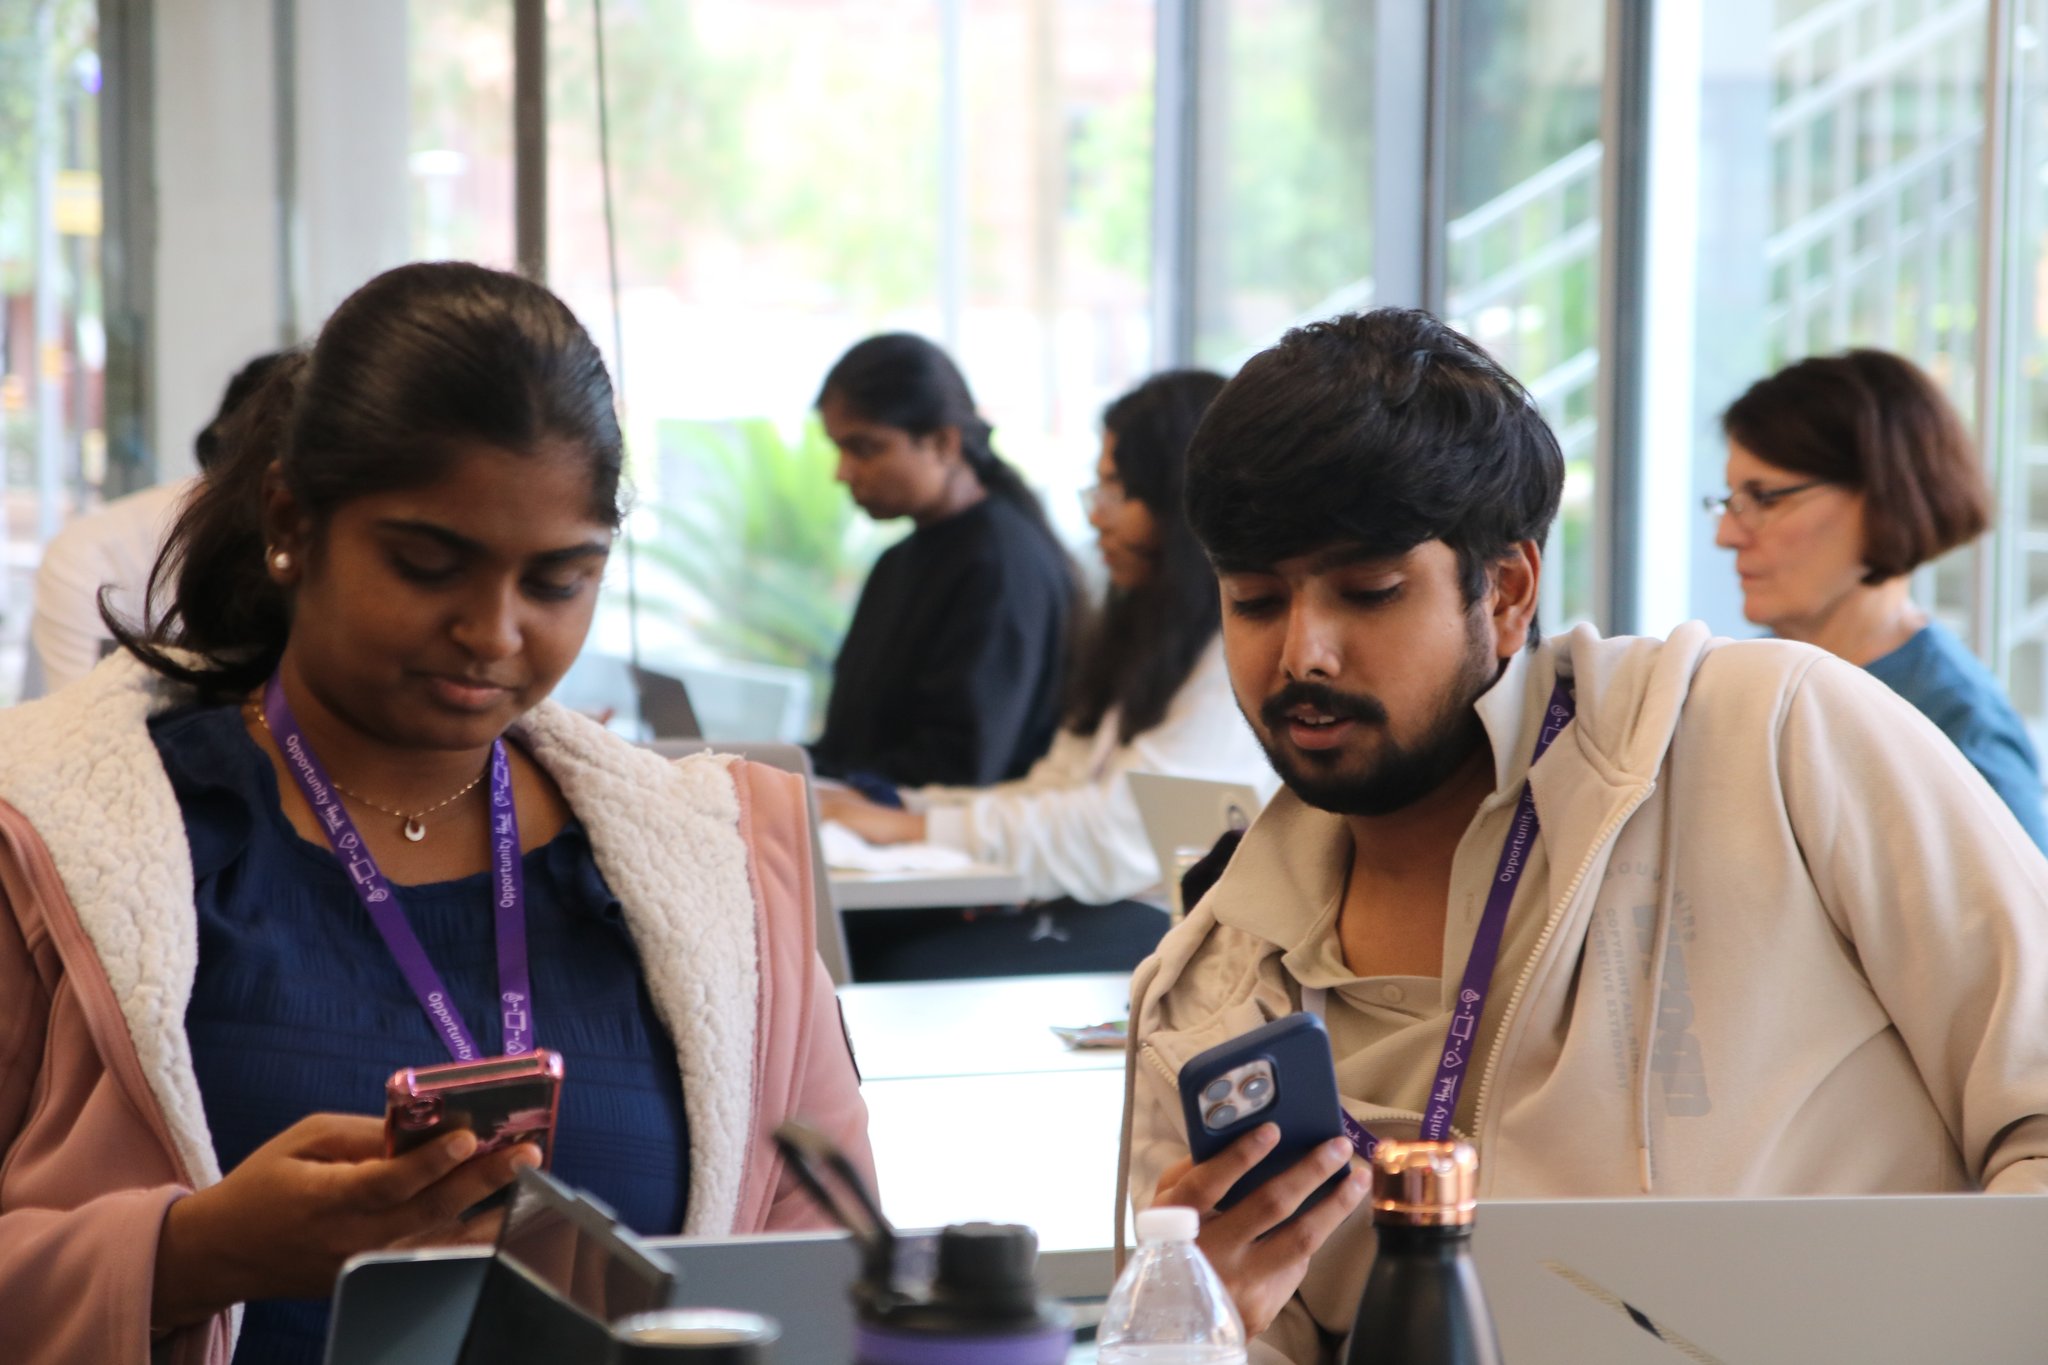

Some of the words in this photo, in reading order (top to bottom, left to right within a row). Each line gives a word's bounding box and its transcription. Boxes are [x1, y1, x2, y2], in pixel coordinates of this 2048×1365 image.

[286, 733, 331, 806] Opportunity
[319, 804, 344, 835] Hack
[496, 812, 513, 837] Hack
[1500, 806, 1536, 882] Opportunity
[498, 837, 517, 908] Opportunity
[428, 990, 475, 1062] Opportunity
[1435, 1074, 1458, 1105] Hack
